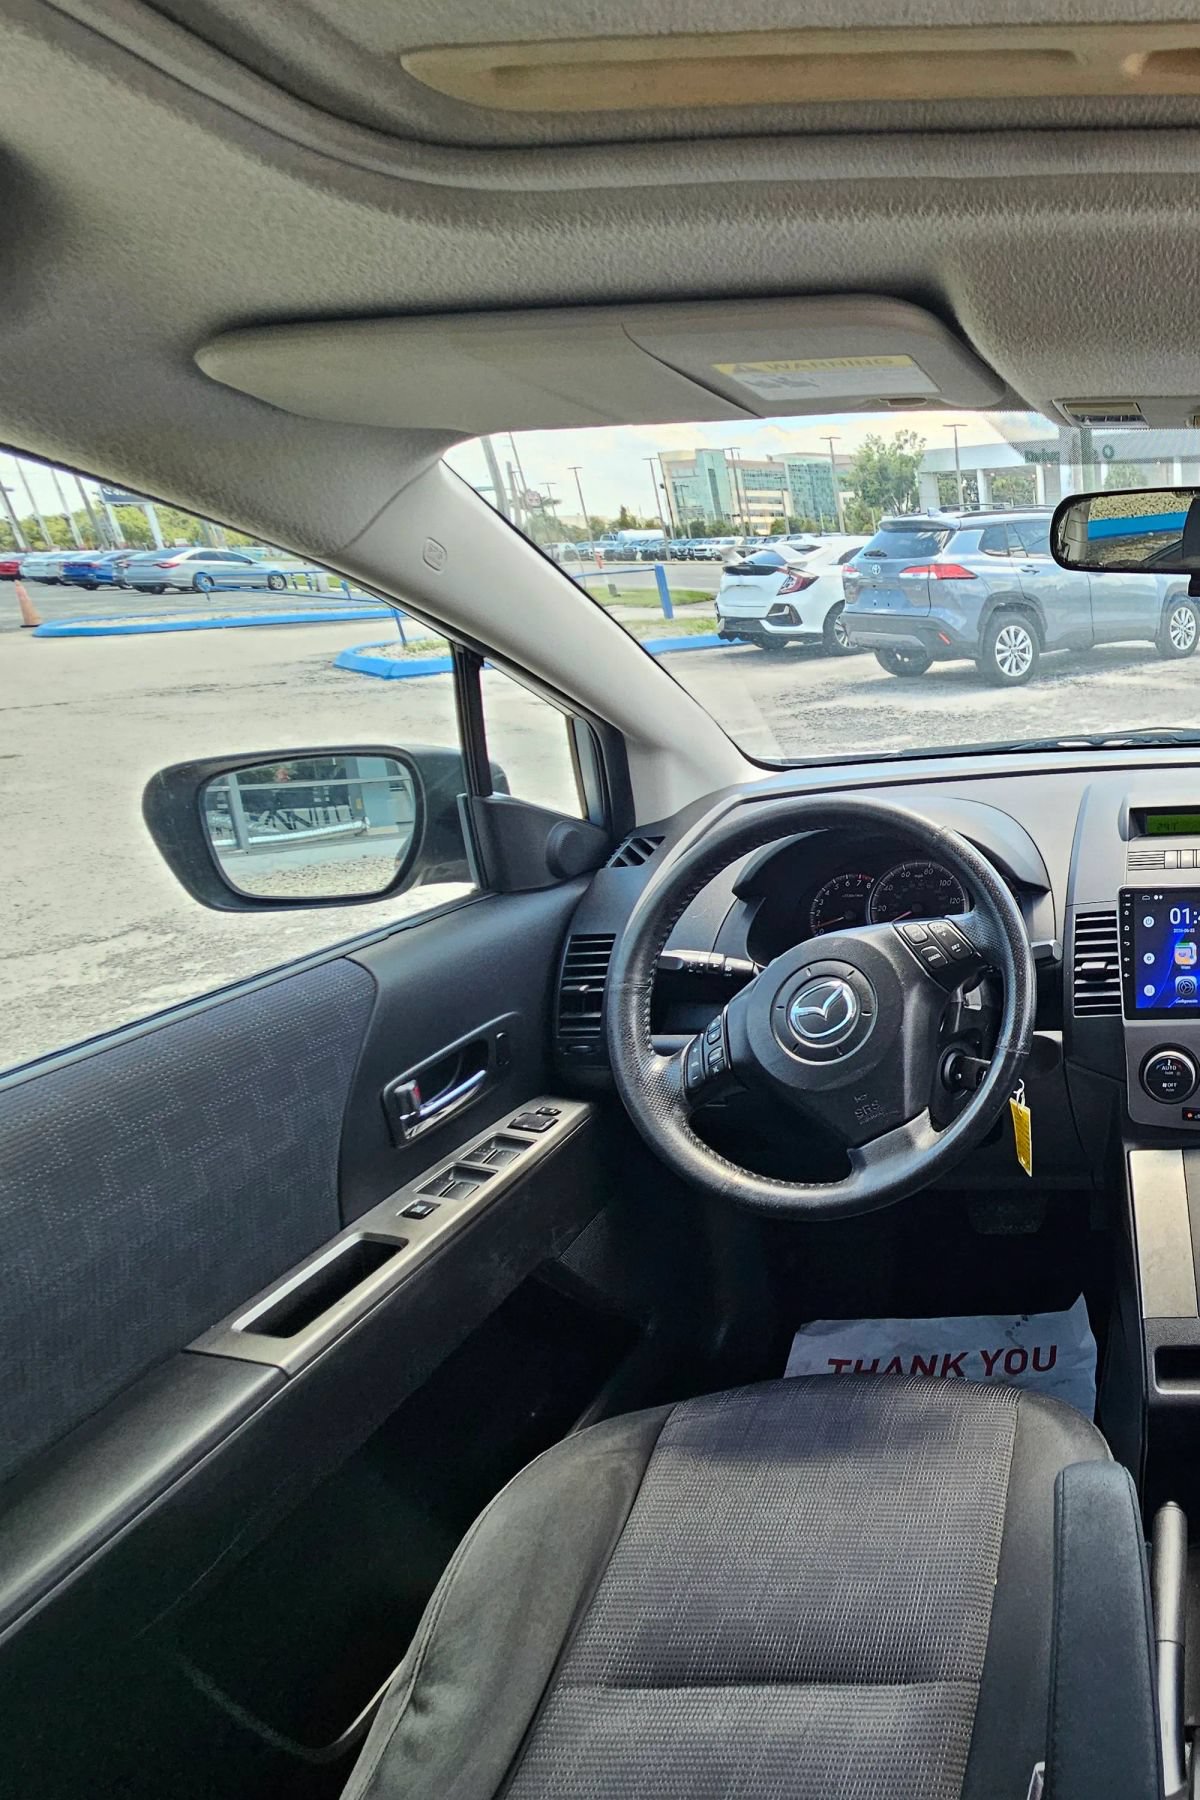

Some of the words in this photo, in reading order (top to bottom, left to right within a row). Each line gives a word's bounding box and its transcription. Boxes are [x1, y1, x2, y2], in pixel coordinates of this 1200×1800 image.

[766, 355, 894, 370] WARNING
[828, 1352, 968, 1377] THANK
[979, 1344, 1057, 1377] YOU
